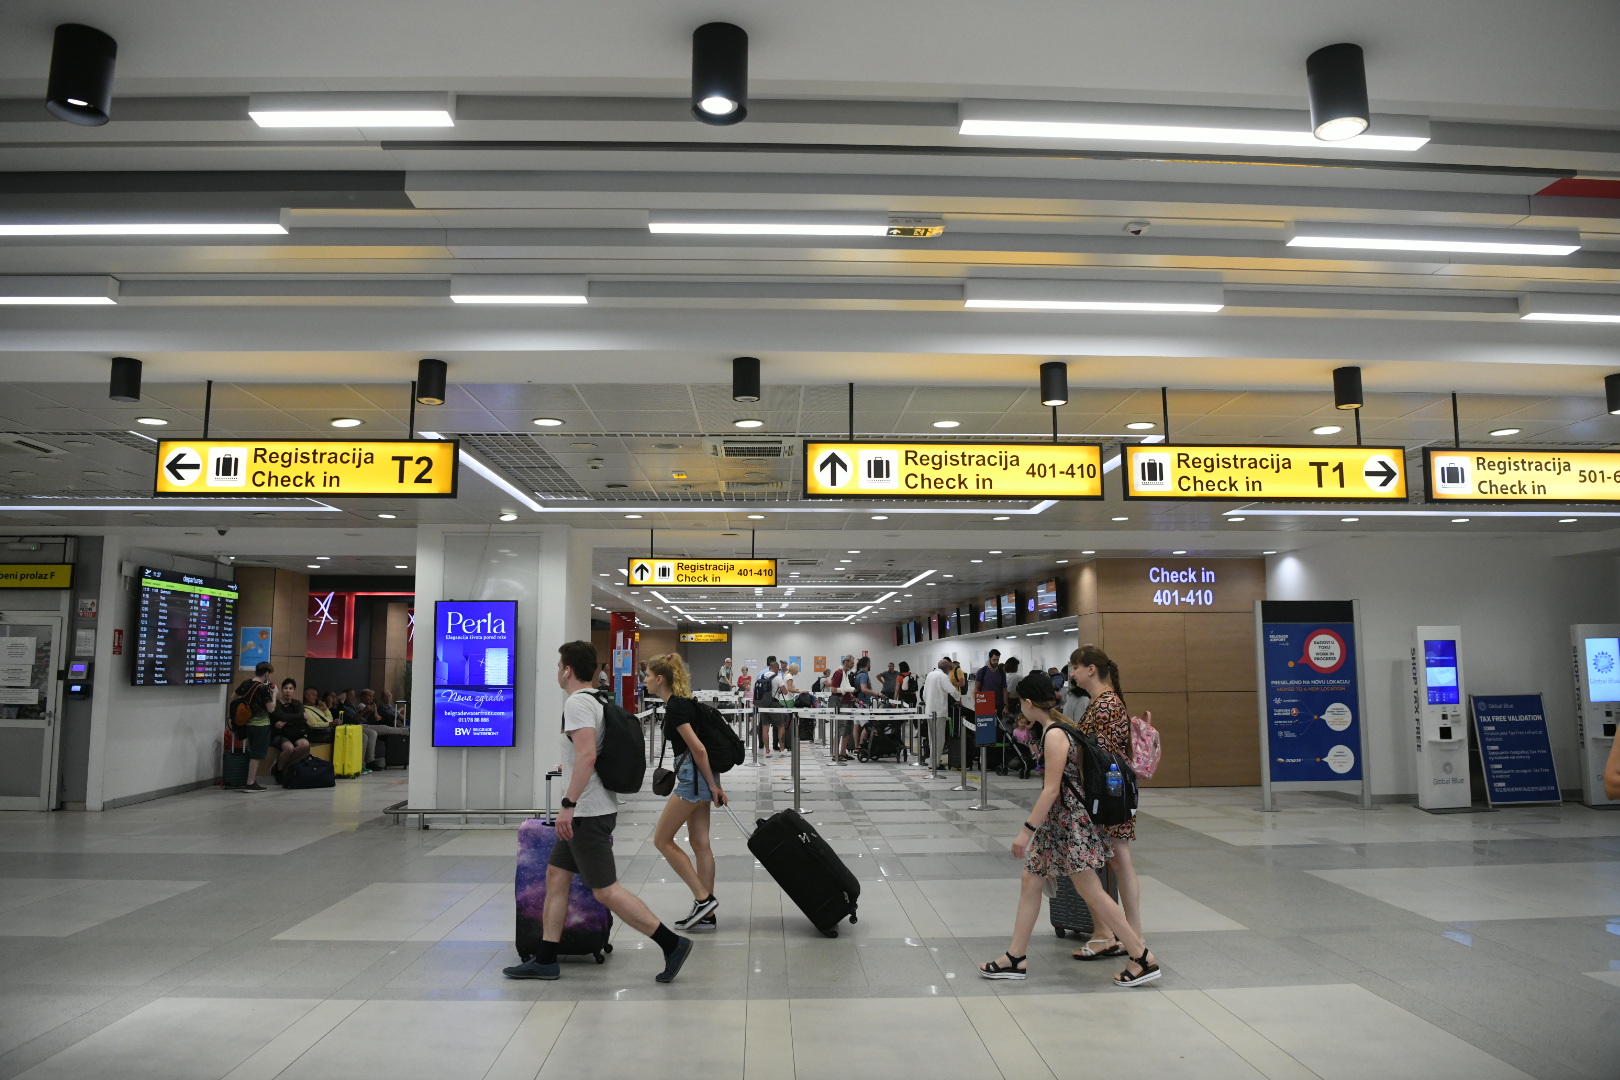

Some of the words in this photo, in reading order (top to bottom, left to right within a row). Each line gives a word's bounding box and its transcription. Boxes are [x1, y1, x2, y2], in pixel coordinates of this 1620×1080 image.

[253, 447, 374, 468] Registracija
[904, 450, 1020, 470] Registracija
[1177, 453, 1292, 473] Registracija
[1476, 456, 1571, 475] Registracija
[251, 470, 315, 487] Check
[323, 471, 340, 487] in
[391, 456, 433, 484] T2
[1026, 463, 1097, 479] 401-410
[1309, 461, 1345, 488] T1
[904, 473, 969, 490] Check
[976, 474, 993, 489] in
[1177, 476, 1239, 491] Check
[1246, 476, 1262, 491] in
[1477, 480, 1528, 495] Check
[1532, 480, 1547, 495] in
[676, 562, 735, 573] Registracija
[737, 568, 773, 577] 401-410
[1149, 567, 1198, 583] Check
[1201, 567, 1215, 583] in
[19, 571, 49, 582] prolaz
[50, 571, 56, 580] F
[182, 574, 204, 586] departures
[676, 573, 708, 582] Check
[711, 573, 721, 582] in
[1153, 589, 1213, 606] 401-410
[446, 611, 507, 634] Perla
[1410, 647, 1418, 686] SHOP
[1572, 646, 1580, 681] SHOP
[440, 689, 473, 702] Nova
[474, 689, 506, 709] zgrada
[454, 727, 472, 736] BW
[1433, 778, 1450, 786] Global
[1451, 777, 1464, 785] Blue
